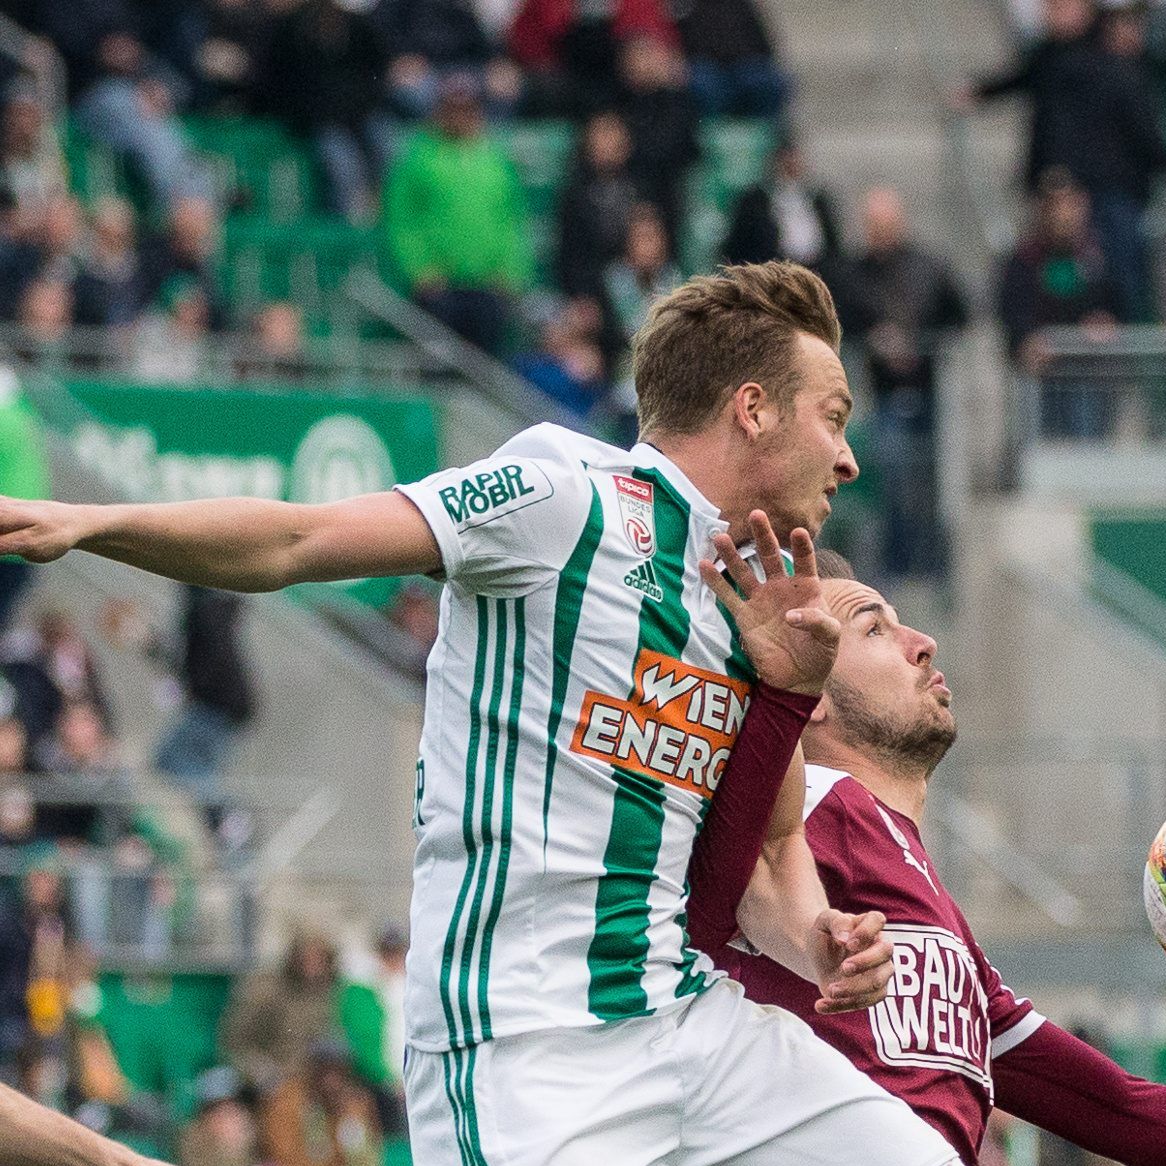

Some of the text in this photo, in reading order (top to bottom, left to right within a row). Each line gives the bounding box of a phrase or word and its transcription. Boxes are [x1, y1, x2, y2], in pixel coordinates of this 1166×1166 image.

[438, 464, 523, 504] RAPID
[444, 476, 535, 524] MOBIL
[624, 574, 663, 602] adidas
